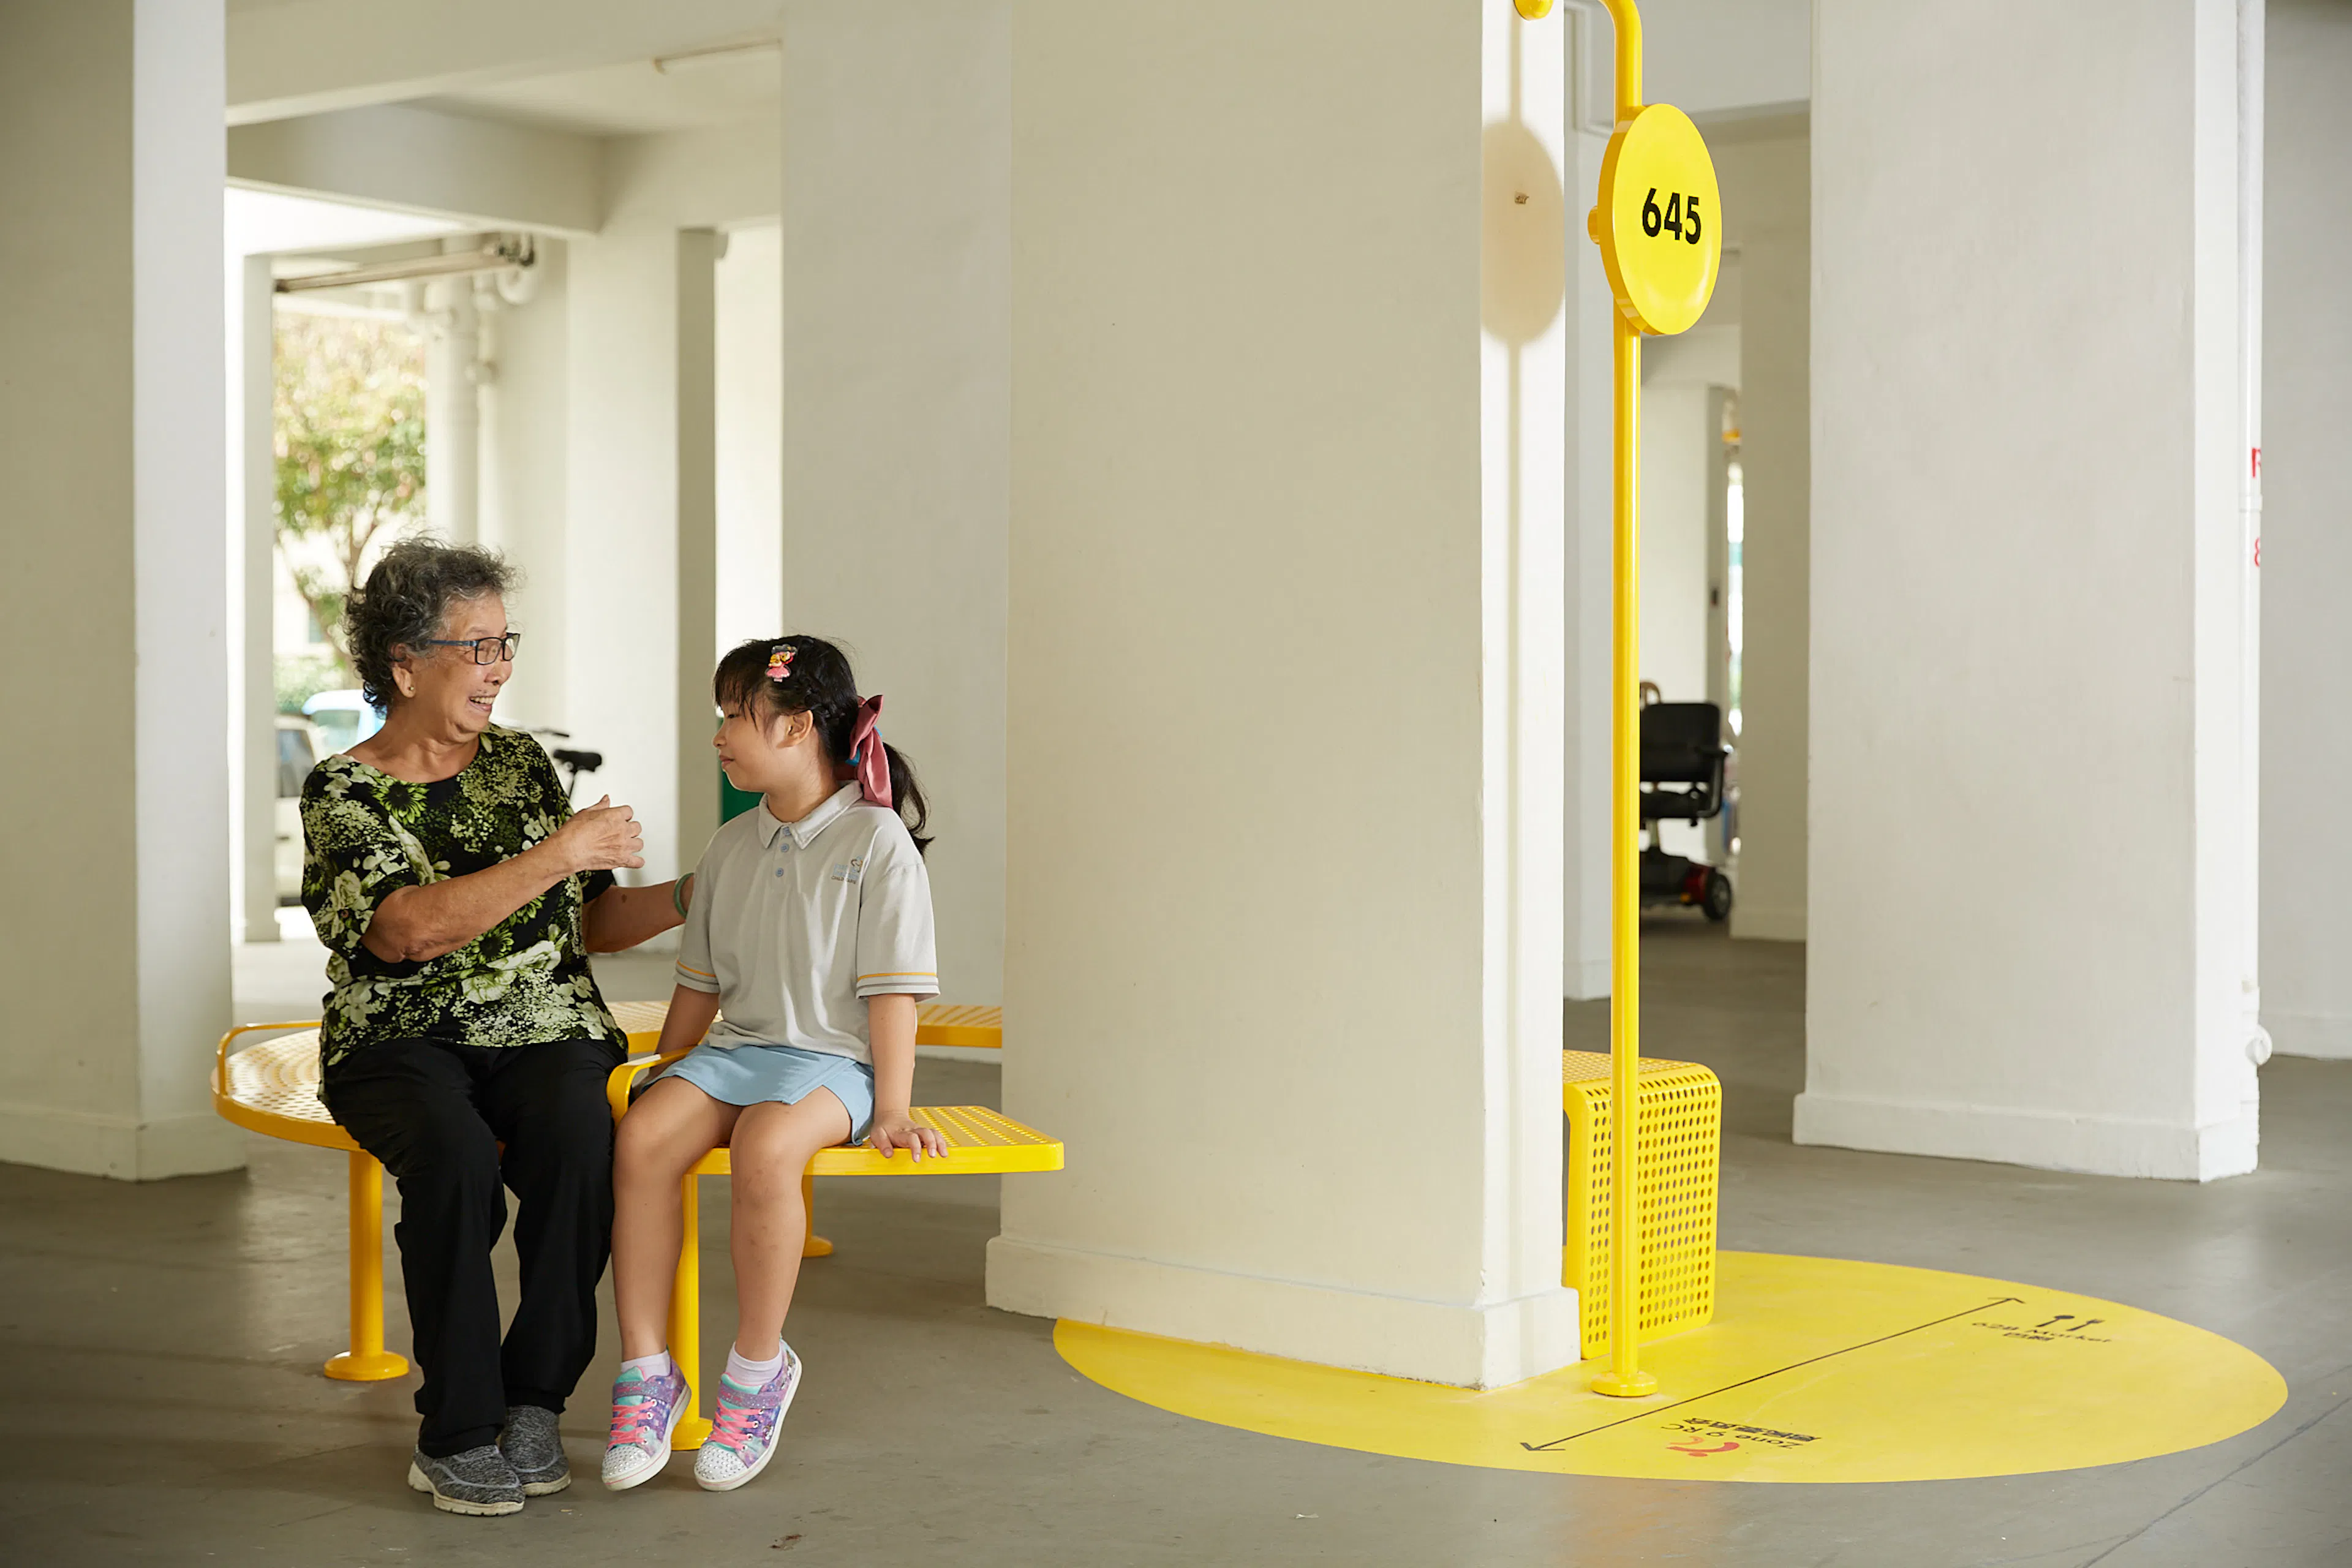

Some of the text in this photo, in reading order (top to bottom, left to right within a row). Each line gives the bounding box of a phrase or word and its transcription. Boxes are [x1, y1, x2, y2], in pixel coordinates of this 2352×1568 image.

[1642, 188, 1702, 244] 645
[1660, 1423, 1703, 1433] RC
[1735, 1434, 1803, 1449] Zone
